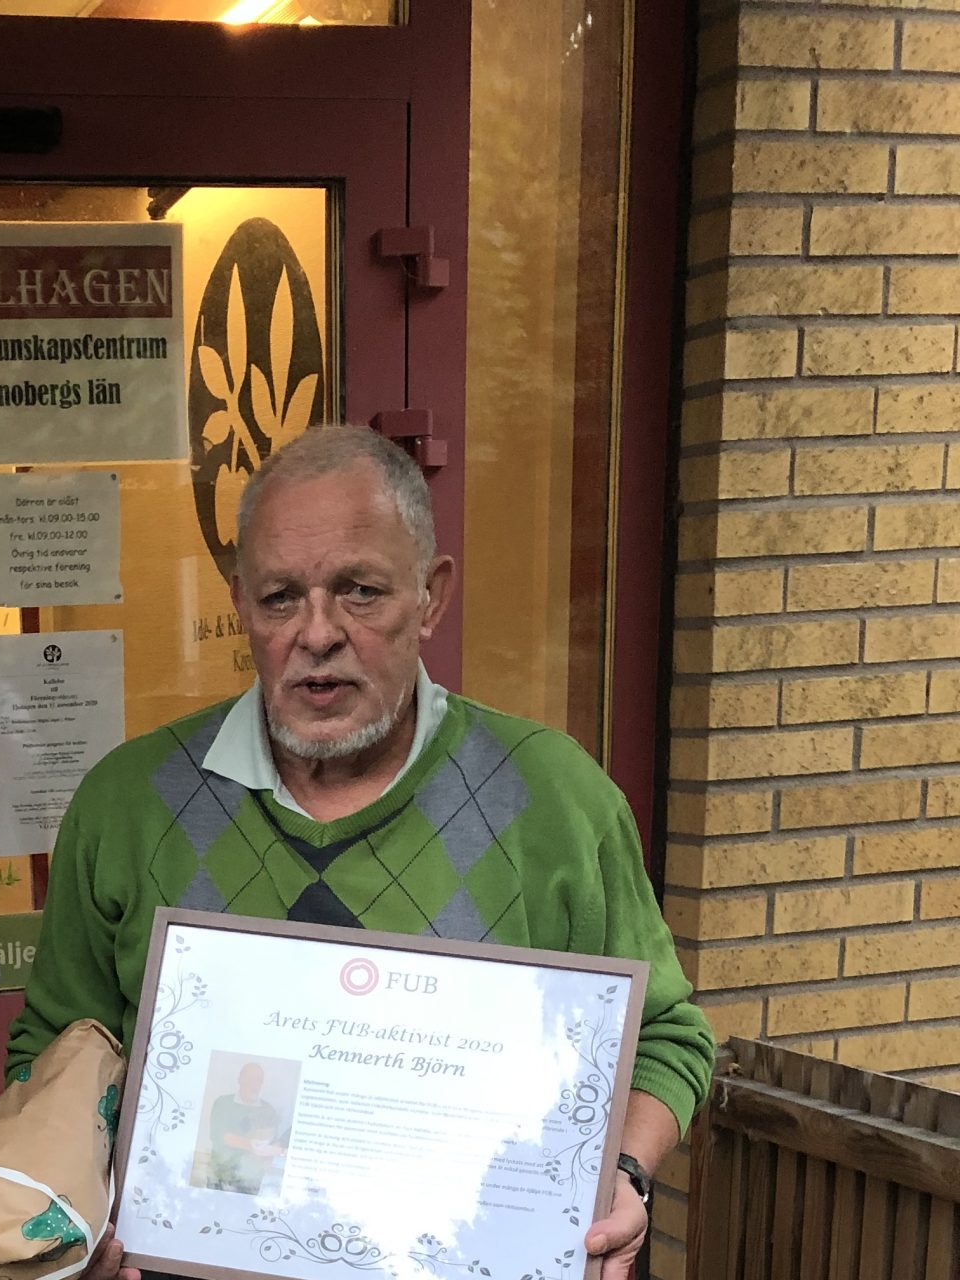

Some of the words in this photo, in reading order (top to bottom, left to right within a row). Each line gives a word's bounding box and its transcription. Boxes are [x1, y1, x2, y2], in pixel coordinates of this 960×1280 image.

[87, 378, 122, 406] län
[385, 971, 438, 995] FUB
[321, 1018, 452, 1049] FUB-aktivist
[456, 1037, 504, 1054] 2020
[308, 1044, 405, 1070] Kennerth
[410, 1055, 466, 1078] Björn
